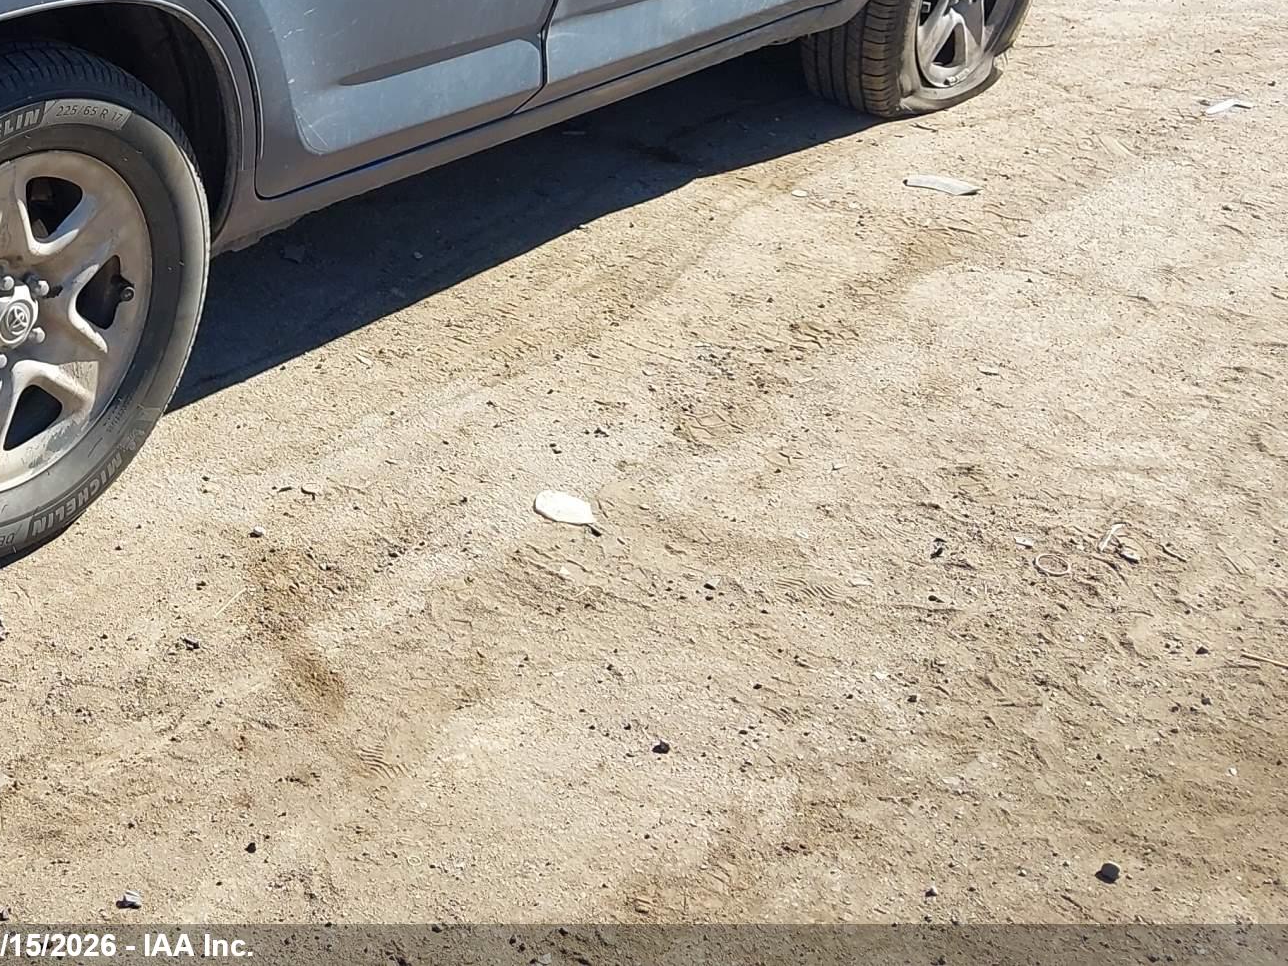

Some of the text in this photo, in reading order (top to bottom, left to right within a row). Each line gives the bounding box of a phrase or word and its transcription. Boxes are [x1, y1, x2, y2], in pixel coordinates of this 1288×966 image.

[55, 105, 98, 117] 225/65
[100, 108, 109, 120] R
[111, 111, 124, 123] 17
[32, 451, 123, 537] MICHELIN
